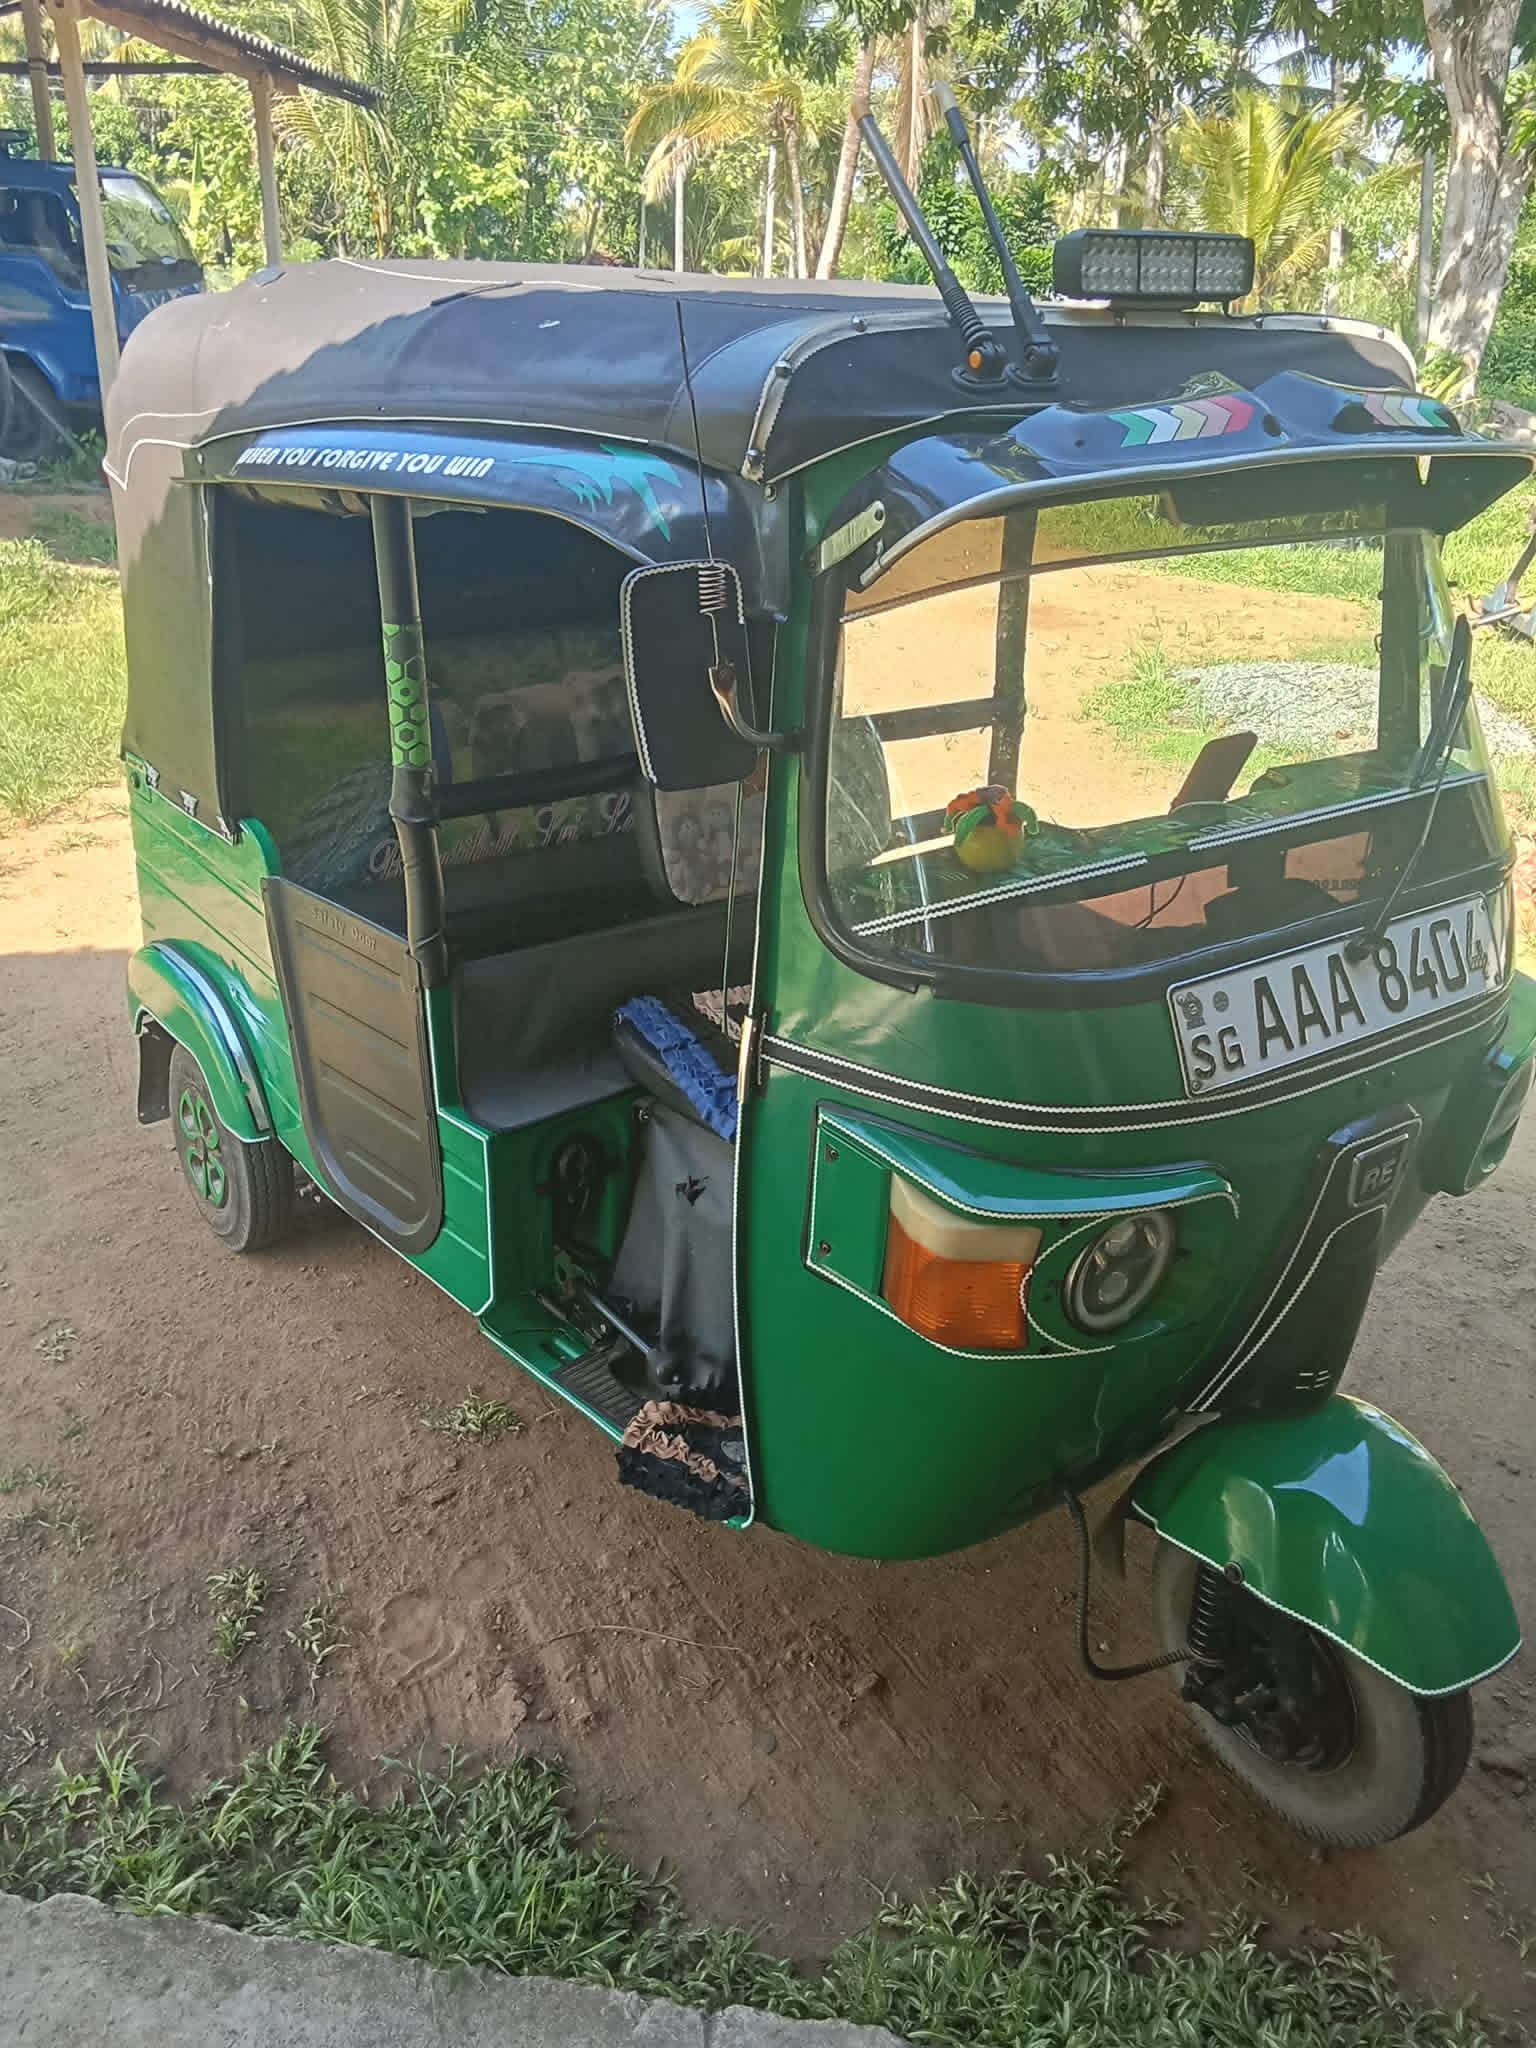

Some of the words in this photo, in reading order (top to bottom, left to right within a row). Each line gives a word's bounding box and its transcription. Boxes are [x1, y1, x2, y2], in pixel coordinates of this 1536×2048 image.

[237, 447, 281, 466] WHEN
[277, 447, 318, 466] YOU
[312, 448, 399, 471] FORGIVE
[395, 451, 444, 477] YOU
[443, 457, 496, 478] WIN
[1190, 1025, 1246, 1079] SG
[1252, 952, 1367, 1060] AAA
[1371, 909, 1489, 1014] 8404
[1359, 1159, 1397, 1194] RE
